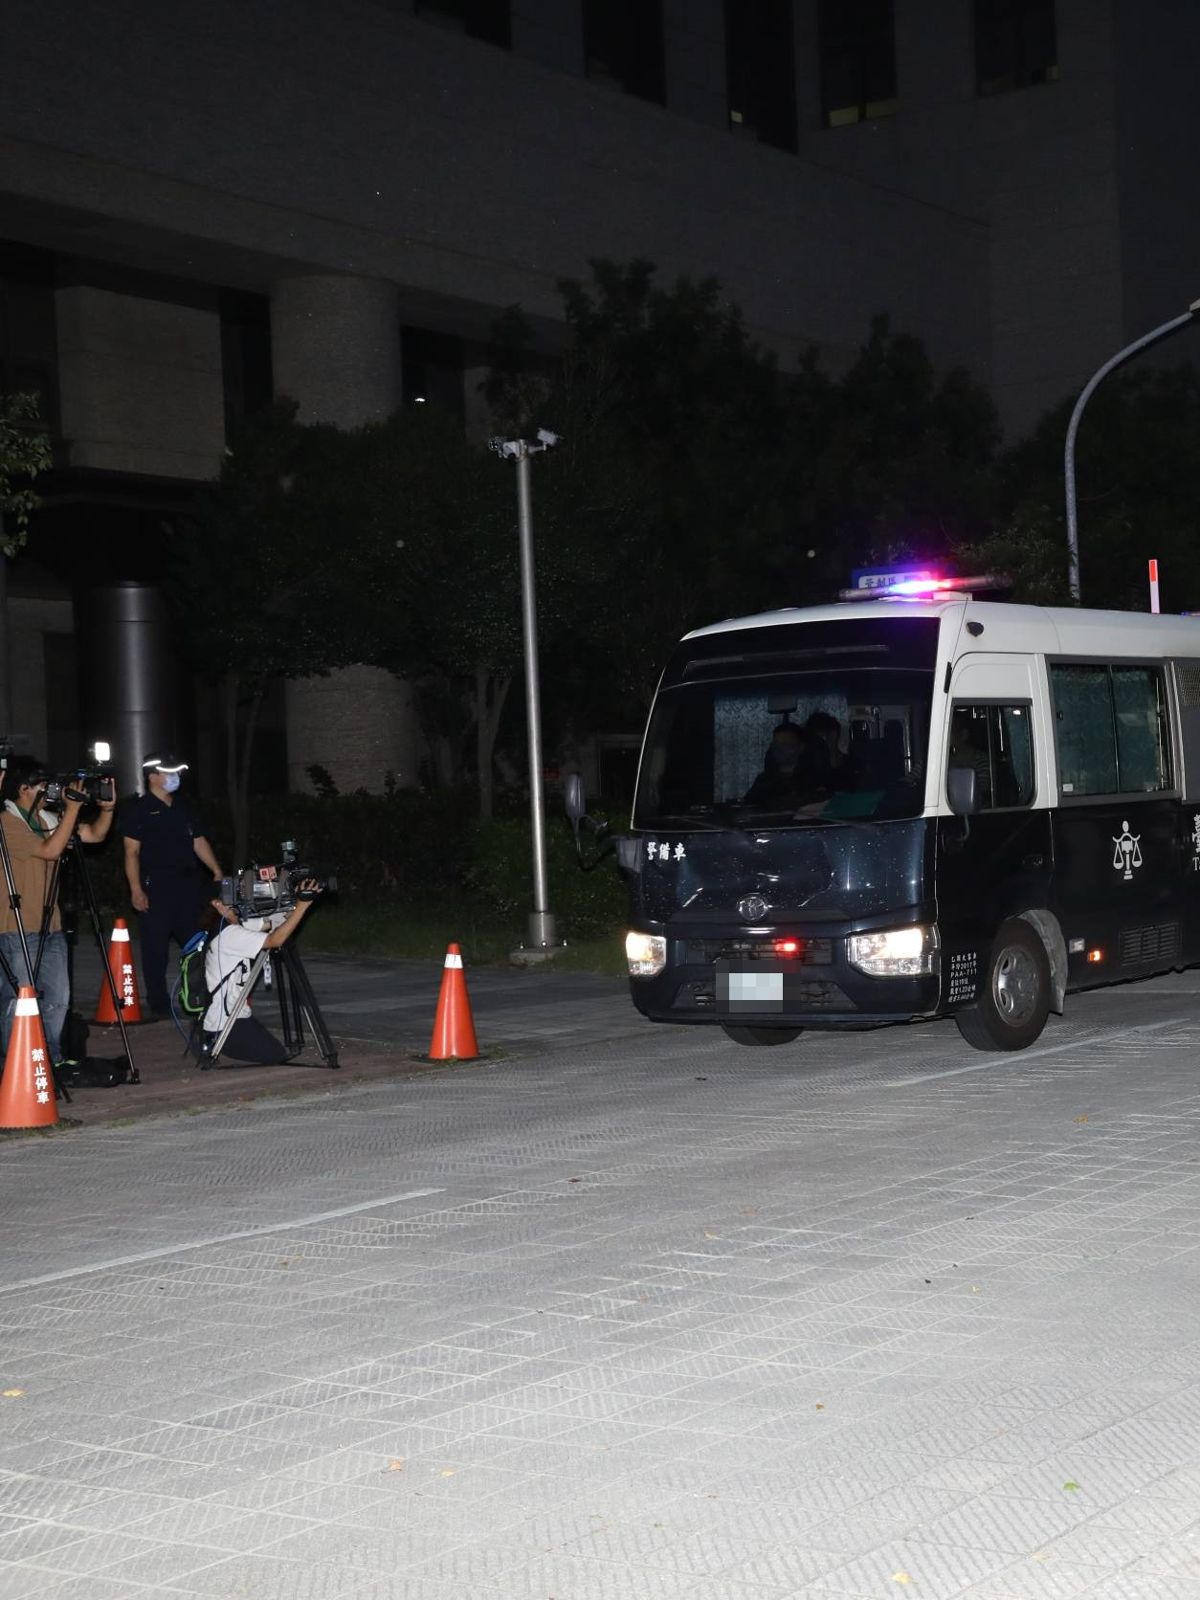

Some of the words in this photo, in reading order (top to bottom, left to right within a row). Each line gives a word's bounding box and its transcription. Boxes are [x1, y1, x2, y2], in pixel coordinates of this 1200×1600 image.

[122, 964, 135, 1007] 禁止停車
[31, 1048, 50, 1105] 禁止停車
